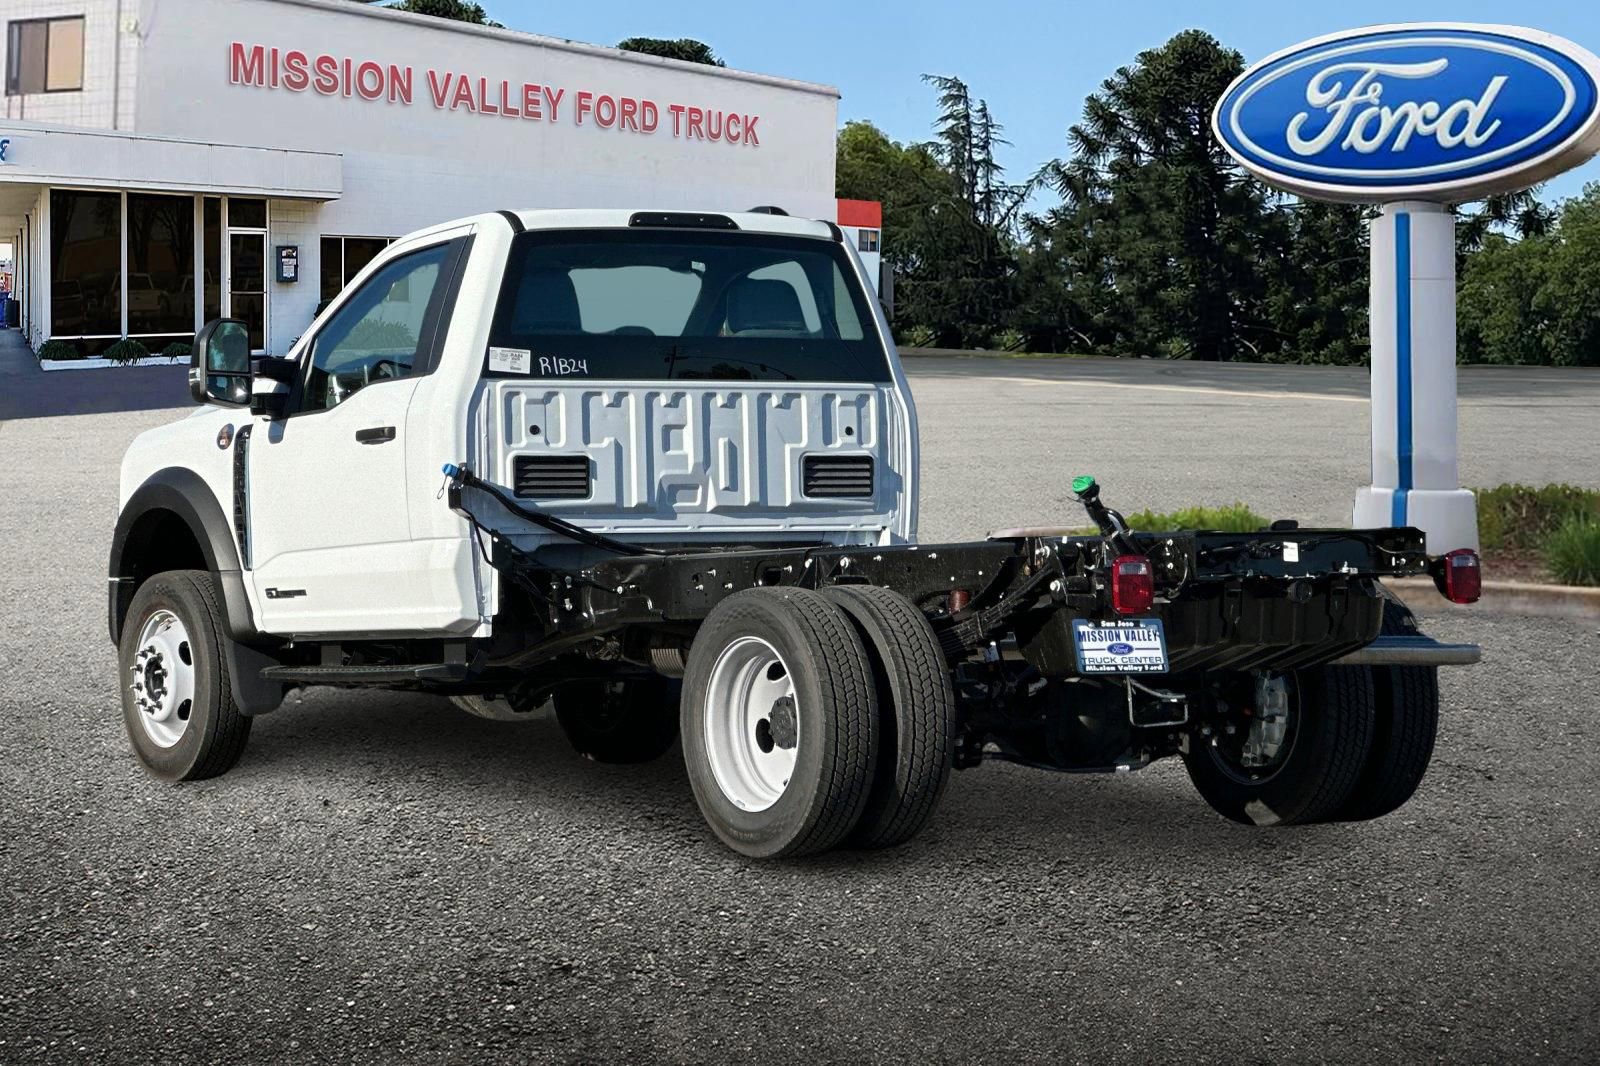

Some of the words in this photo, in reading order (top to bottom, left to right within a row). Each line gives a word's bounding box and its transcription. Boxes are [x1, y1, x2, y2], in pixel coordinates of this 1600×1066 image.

[229, 40, 414, 105] MISSION
[427, 68, 565, 122] VALLEY
[575, 90, 660, 134] FORD
[669, 103, 761, 147] TRUCK
[1286, 57, 1509, 156] Ford
[1101, 620, 1116, 628] San
[1118, 620, 1135, 628] Jose
[1078, 630, 1121, 642] MISSION
[1124, 630, 1158, 642] VALLEY
[1111, 644, 1129, 654] Ford
[1081, 656, 1117, 664] TRUCK
[1121, 656, 1162, 664] CENTER
[1118, 664, 1142, 672] Valley
